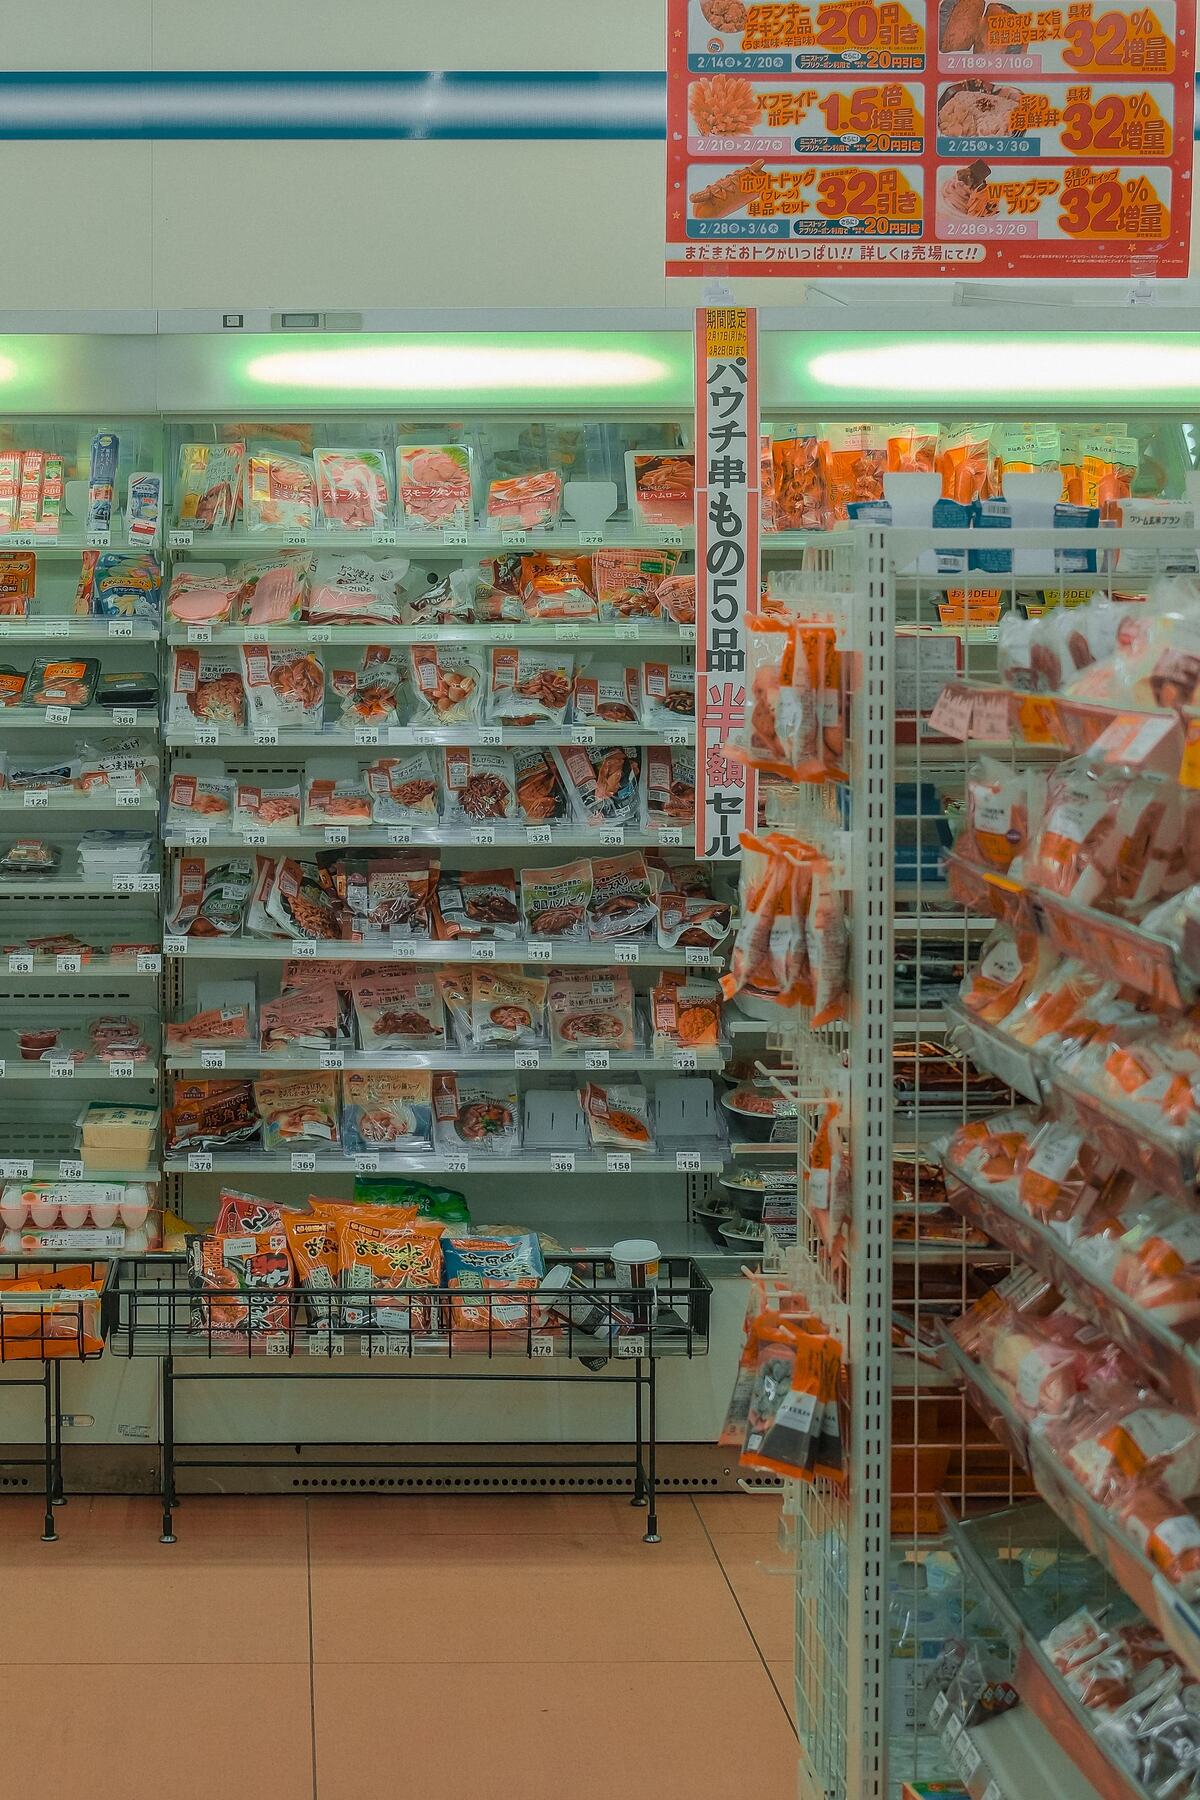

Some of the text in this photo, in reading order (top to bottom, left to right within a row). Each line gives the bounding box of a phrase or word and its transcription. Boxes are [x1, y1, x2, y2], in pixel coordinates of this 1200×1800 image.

[748, 4, 811, 23] クランキー
[1068, 4, 1092, 19] 具材
[745, 19, 812, 38] チキン2品
[1123, 37, 1167, 67] 増量
[1021, 95, 1049, 112] 彩り
[1066, 87, 1091, 102] 具材
[768, 110, 807, 127] ポテト
[1010, 110, 1060, 131] 海鮮丼
[1122, 120, 1165, 151] 増量
[741, 169, 817, 192] ホットドッグ
[1064, 168, 1090, 180] 2種の
[760, 190, 800, 201] (プレーン)
[988, 180, 1060, 201] Wモンブラン
[748, 201, 810, 217] 単品・セット
[1007, 198, 1041, 216] プリン
[1118, 203, 1163, 233] 増量
[706, 309, 747, 329] 期間限定
[640, 491, 687, 500] 生ハムロース
